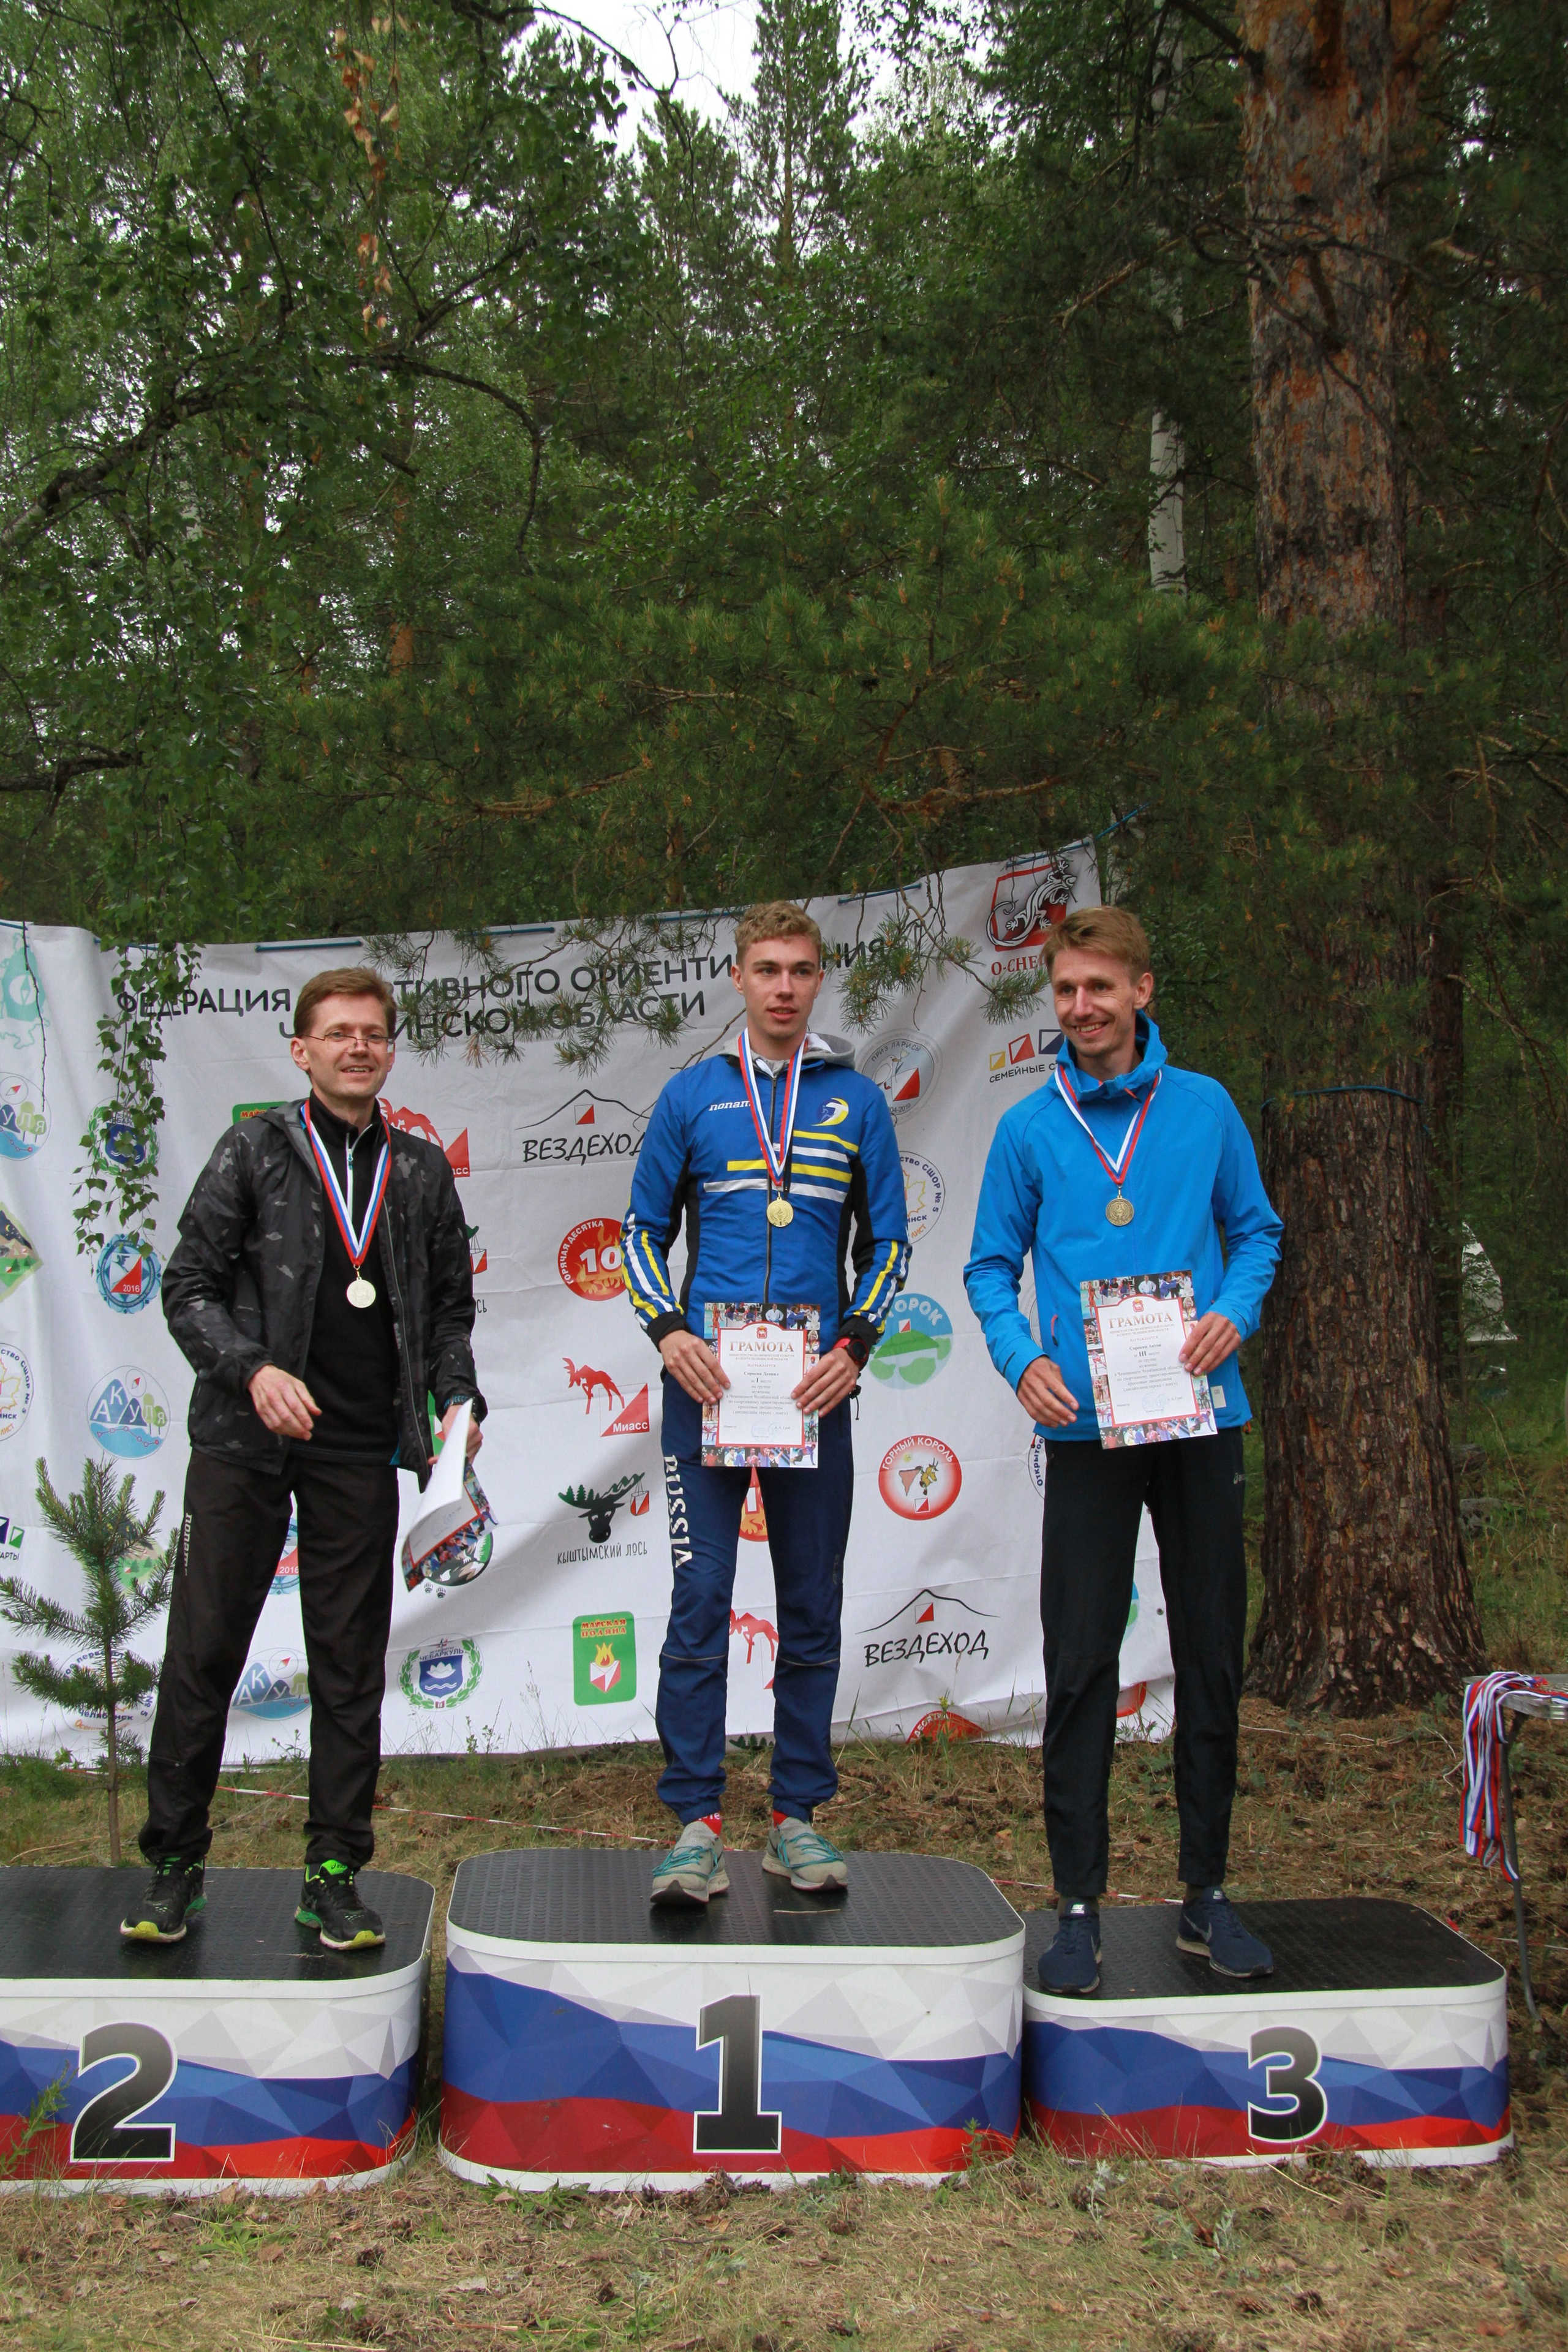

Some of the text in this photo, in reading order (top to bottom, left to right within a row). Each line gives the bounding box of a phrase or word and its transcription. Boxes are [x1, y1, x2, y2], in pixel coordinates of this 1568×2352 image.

[871, 1041, 921, 1061] ПРИЗ ЛАРИСЫ
[989, 1064, 1046, 1083] СЕМЕЙНЫЕ
[709, 1100, 751, 1111] nonam
[922, 1164, 941, 1189] СШОР
[560, 1220, 604, 1285] ГОРЯЧАЯ ДЕСЯТКА
[579, 1246, 622, 1273] 10
[889, 1297, 943, 1326] ОРОК
[1108, 1313, 1174, 1329] ГРАМОТА
[729, 1341, 794, 1352] ГРАМОТА
[20, 1360, 31, 1389] СШОР
[612, 1422, 648, 1433] Миасс
[882, 1437, 954, 1469] ГОРНЫЙ КОРОЛЬ
[1033, 1438, 1044, 1486] Открытое
[664, 1455, 693, 1568] RUSSIA
[557, 1541, 647, 1564] КЫШТЫМСКИЙ ЛОСЬ
[581, 1618, 627, 1629] МАЙСКАЯ
[581, 1627, 627, 1638] ПОЛЯНА
[420, 1648, 464, 1660] ЧЕБАРКУЛЬ
[864, 1629, 989, 1667] ВЕЗДЕХОД
[693, 1994, 782, 2153] 1
[1246, 2026, 1328, 2143] 3
[70, 2022, 177, 2163] 2
